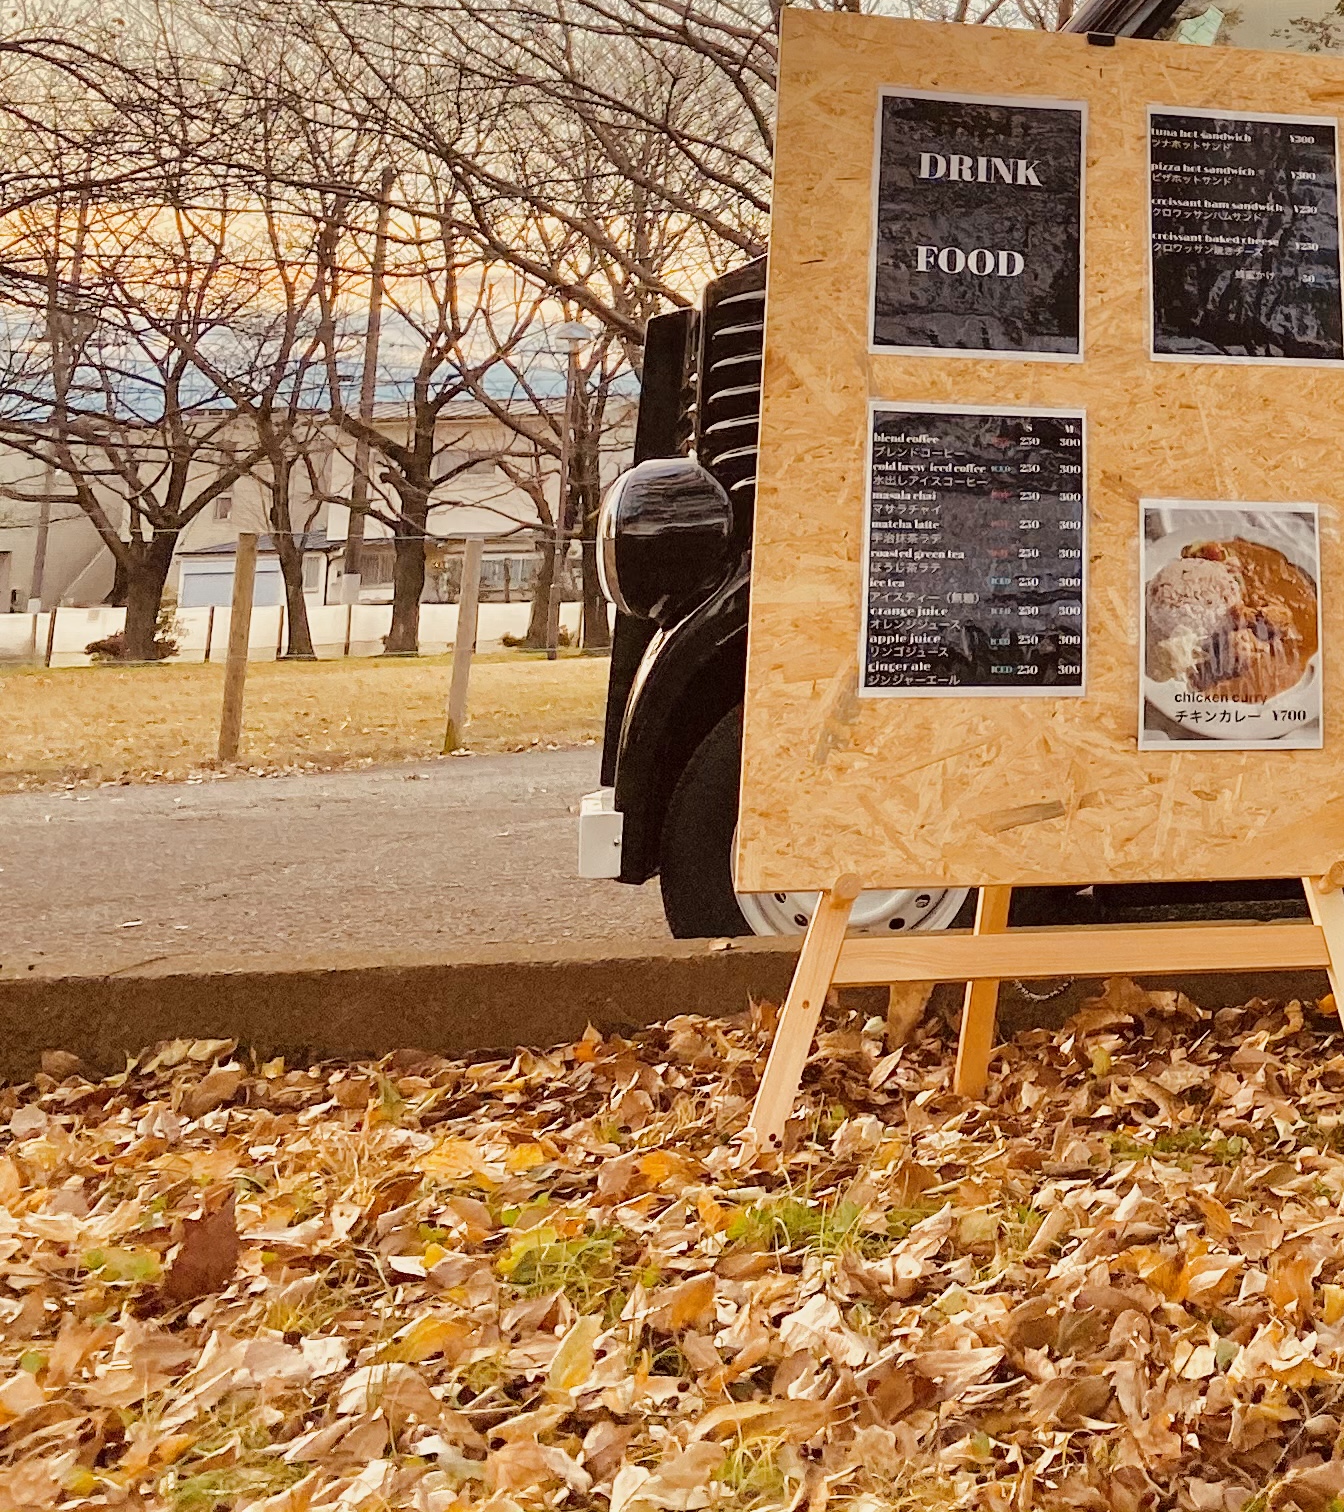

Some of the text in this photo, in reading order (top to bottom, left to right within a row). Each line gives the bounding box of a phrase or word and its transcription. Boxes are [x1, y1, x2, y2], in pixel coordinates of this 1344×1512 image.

[1152, 139, 1232, 151] ツナホットサンド
[918, 152, 1043, 187] DRINK
[916, 245, 1025, 277] FOOD
[874, 433, 904, 443] blend
[906, 434, 939, 443] coffee
[874, 448, 965, 458] ブレンドコーヒー
[954, 464, 986, 473] coffee
[1059, 465, 1080, 474] 300
[874, 476, 989, 486] 水出しアイスコーヒー
[1059, 493, 1080, 501] 300
[873, 505, 941, 514] マサラチャイ
[872, 520, 912, 529] matcha
[1059, 521, 1080, 530] 300
[914, 551, 946, 560] green
[1059, 550, 1080, 558] 300
[871, 563, 940, 573] ほうじ茶ラテ
[1059, 578, 1080, 586] 300
[918, 606, 948, 616] juice
[1059, 607, 1080, 615] 300
[870, 619, 961, 630] オレンジジュース
[869, 635, 909, 644] apple
[910, 635, 941, 645] juice
[1059, 636, 1080, 644] 300
[871, 648, 948, 658] リンゴジュース
[1058, 666, 1080, 674] 300
[868, 676, 960, 686] ジンジャーエール
[1174, 691, 1267, 705] chicken curry
[1175, 709, 1306, 724] チキンカレー ¥700
